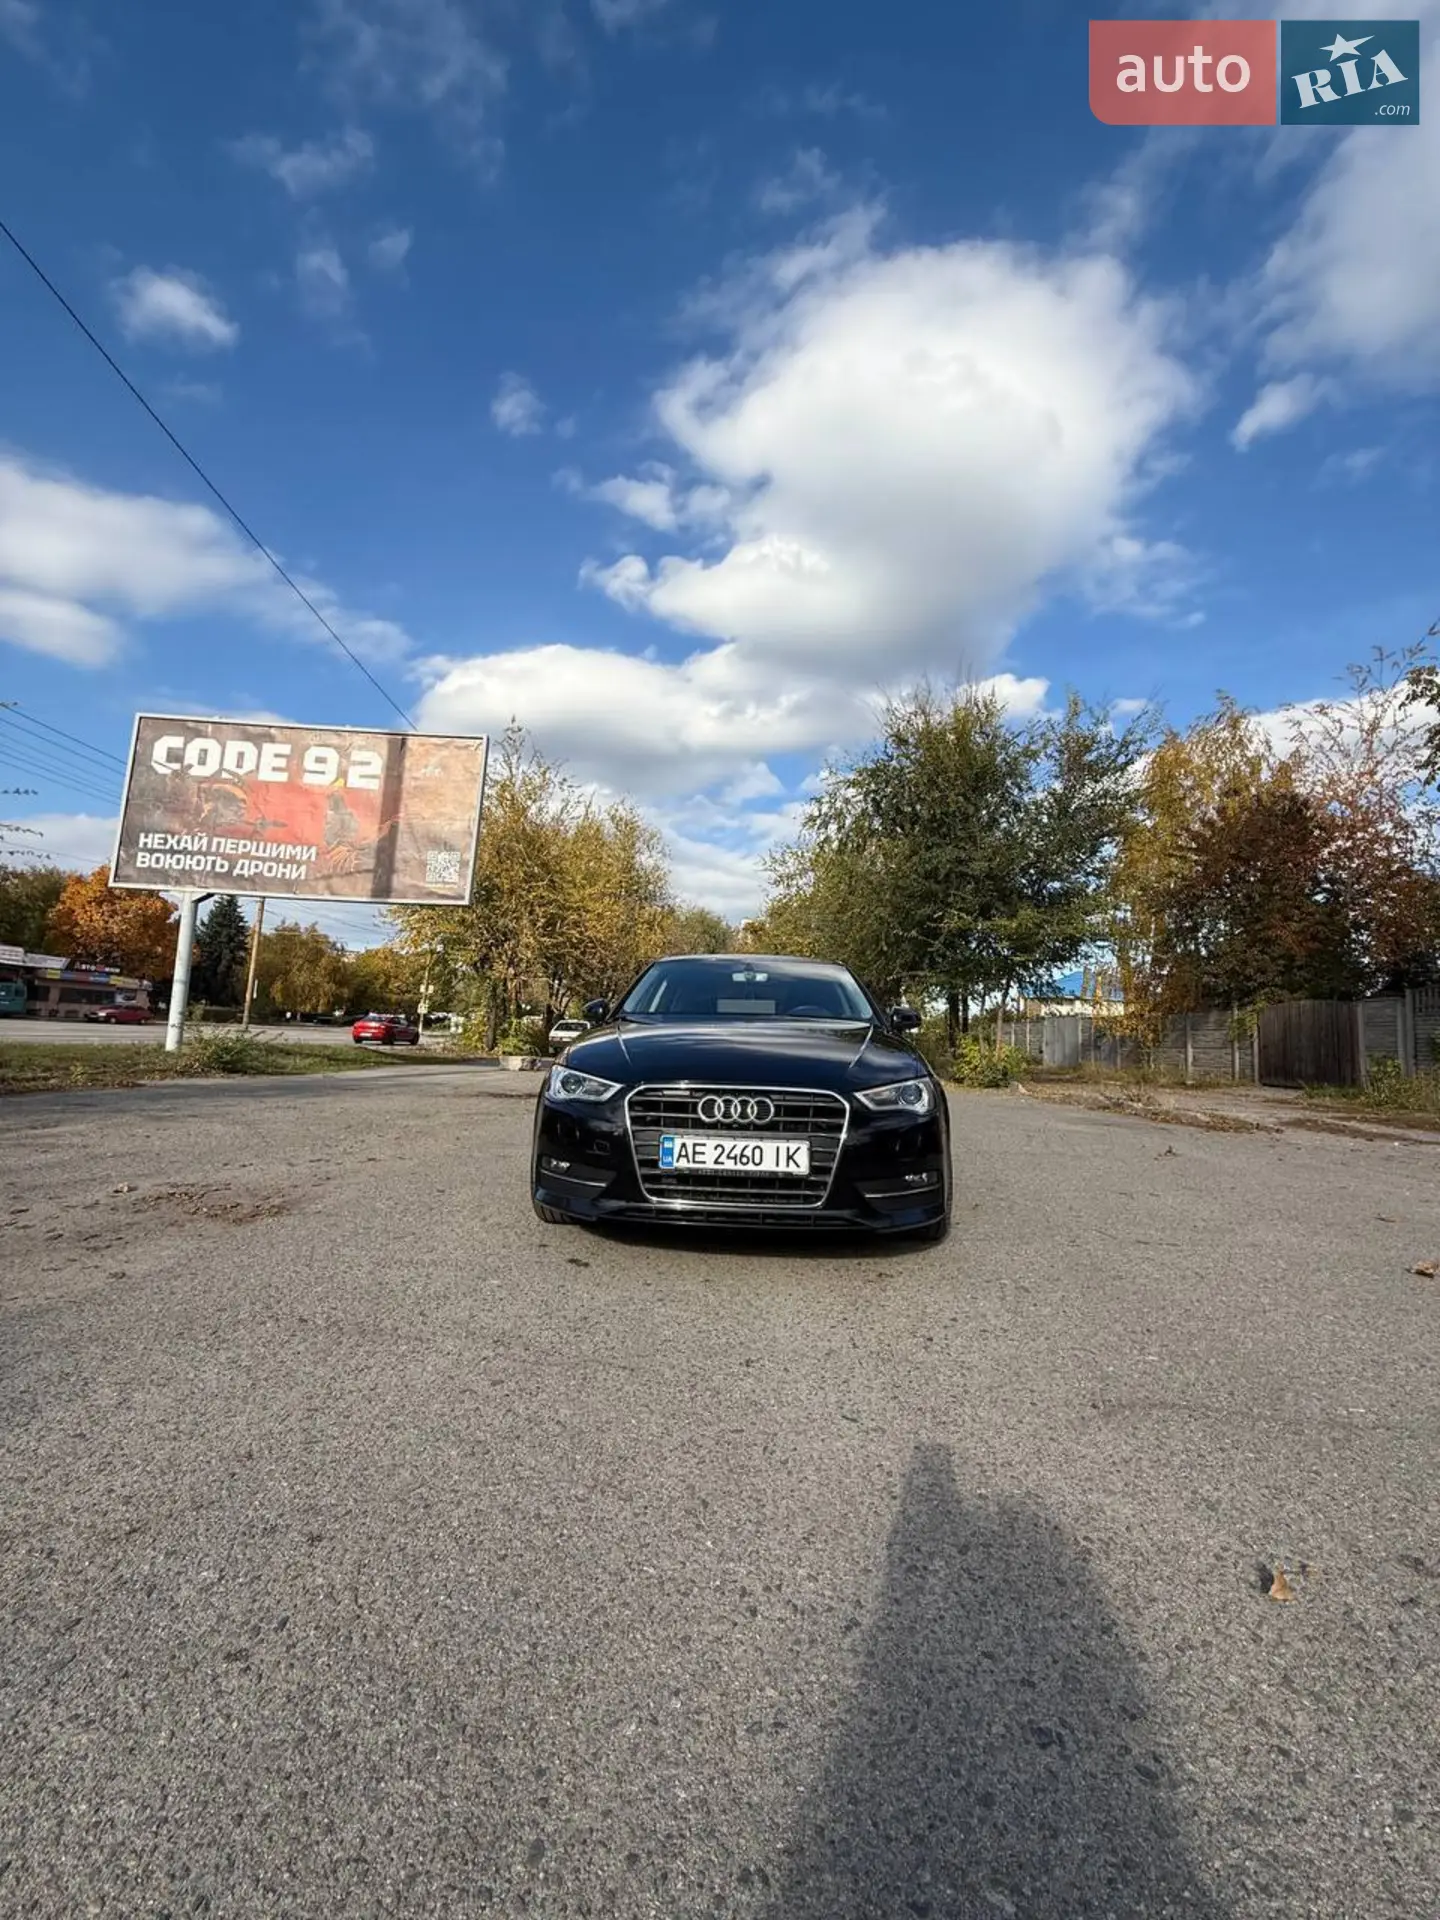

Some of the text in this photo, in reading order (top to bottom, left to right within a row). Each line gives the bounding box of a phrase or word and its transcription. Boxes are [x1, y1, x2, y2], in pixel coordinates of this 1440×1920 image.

[151, 735, 383, 790] CODE 92
[138, 832, 317, 862] НЕХАЙ ПЕРШИМИ
[136, 851, 307, 880] ВОЮЮТЬ ДРОНИ
[676, 1142, 801, 1169] AE 2460 IK
